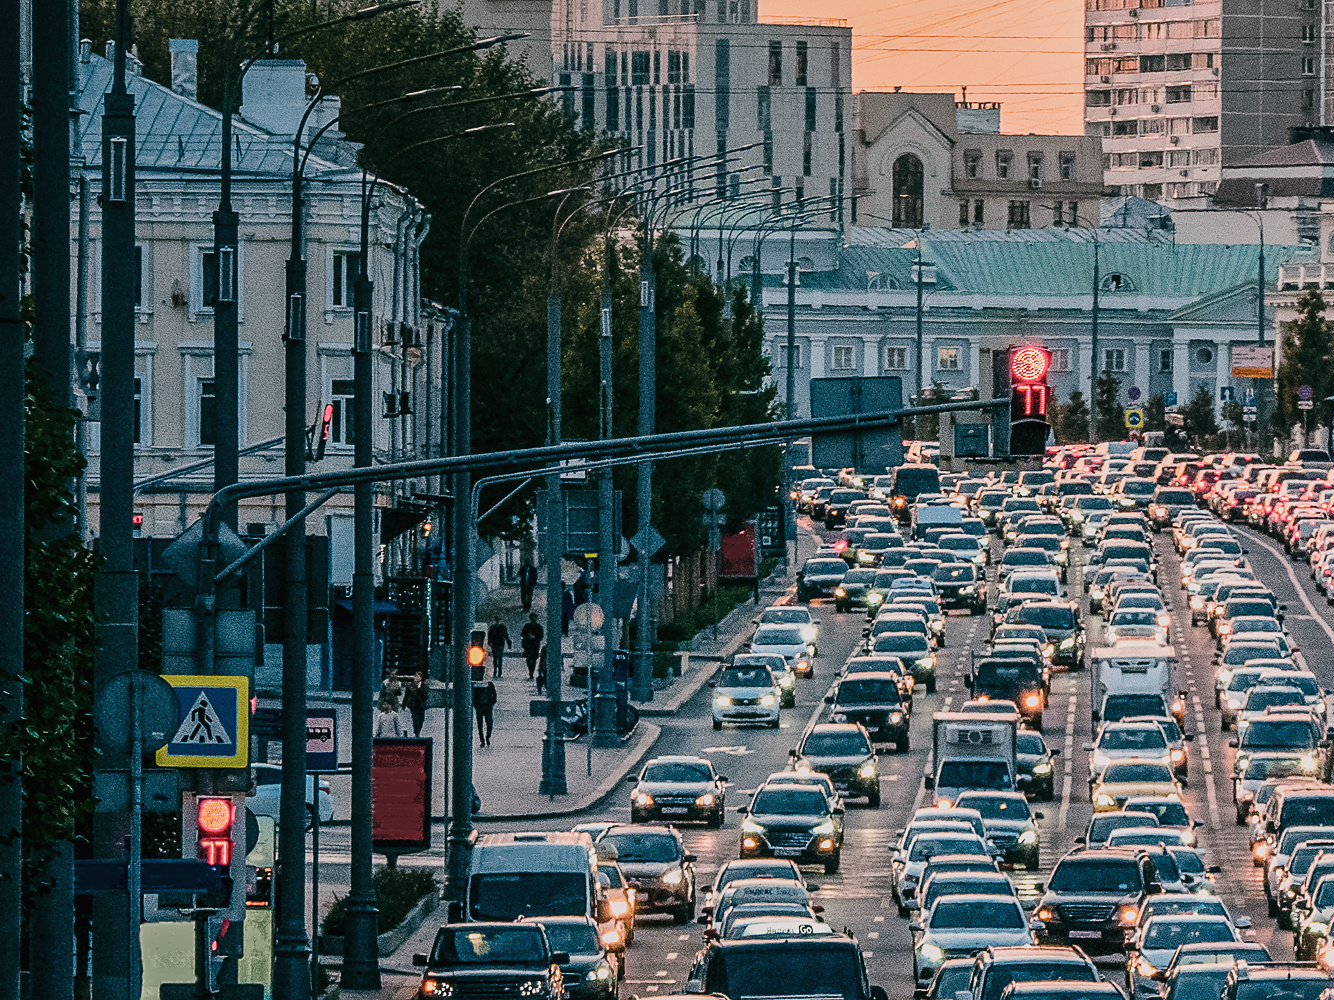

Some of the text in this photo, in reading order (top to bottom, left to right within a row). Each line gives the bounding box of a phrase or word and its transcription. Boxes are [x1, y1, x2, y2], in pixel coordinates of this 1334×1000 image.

[1017, 385, 1045, 415] 77
[200, 840, 229, 866] 77
[799, 925, 813, 935] Go
